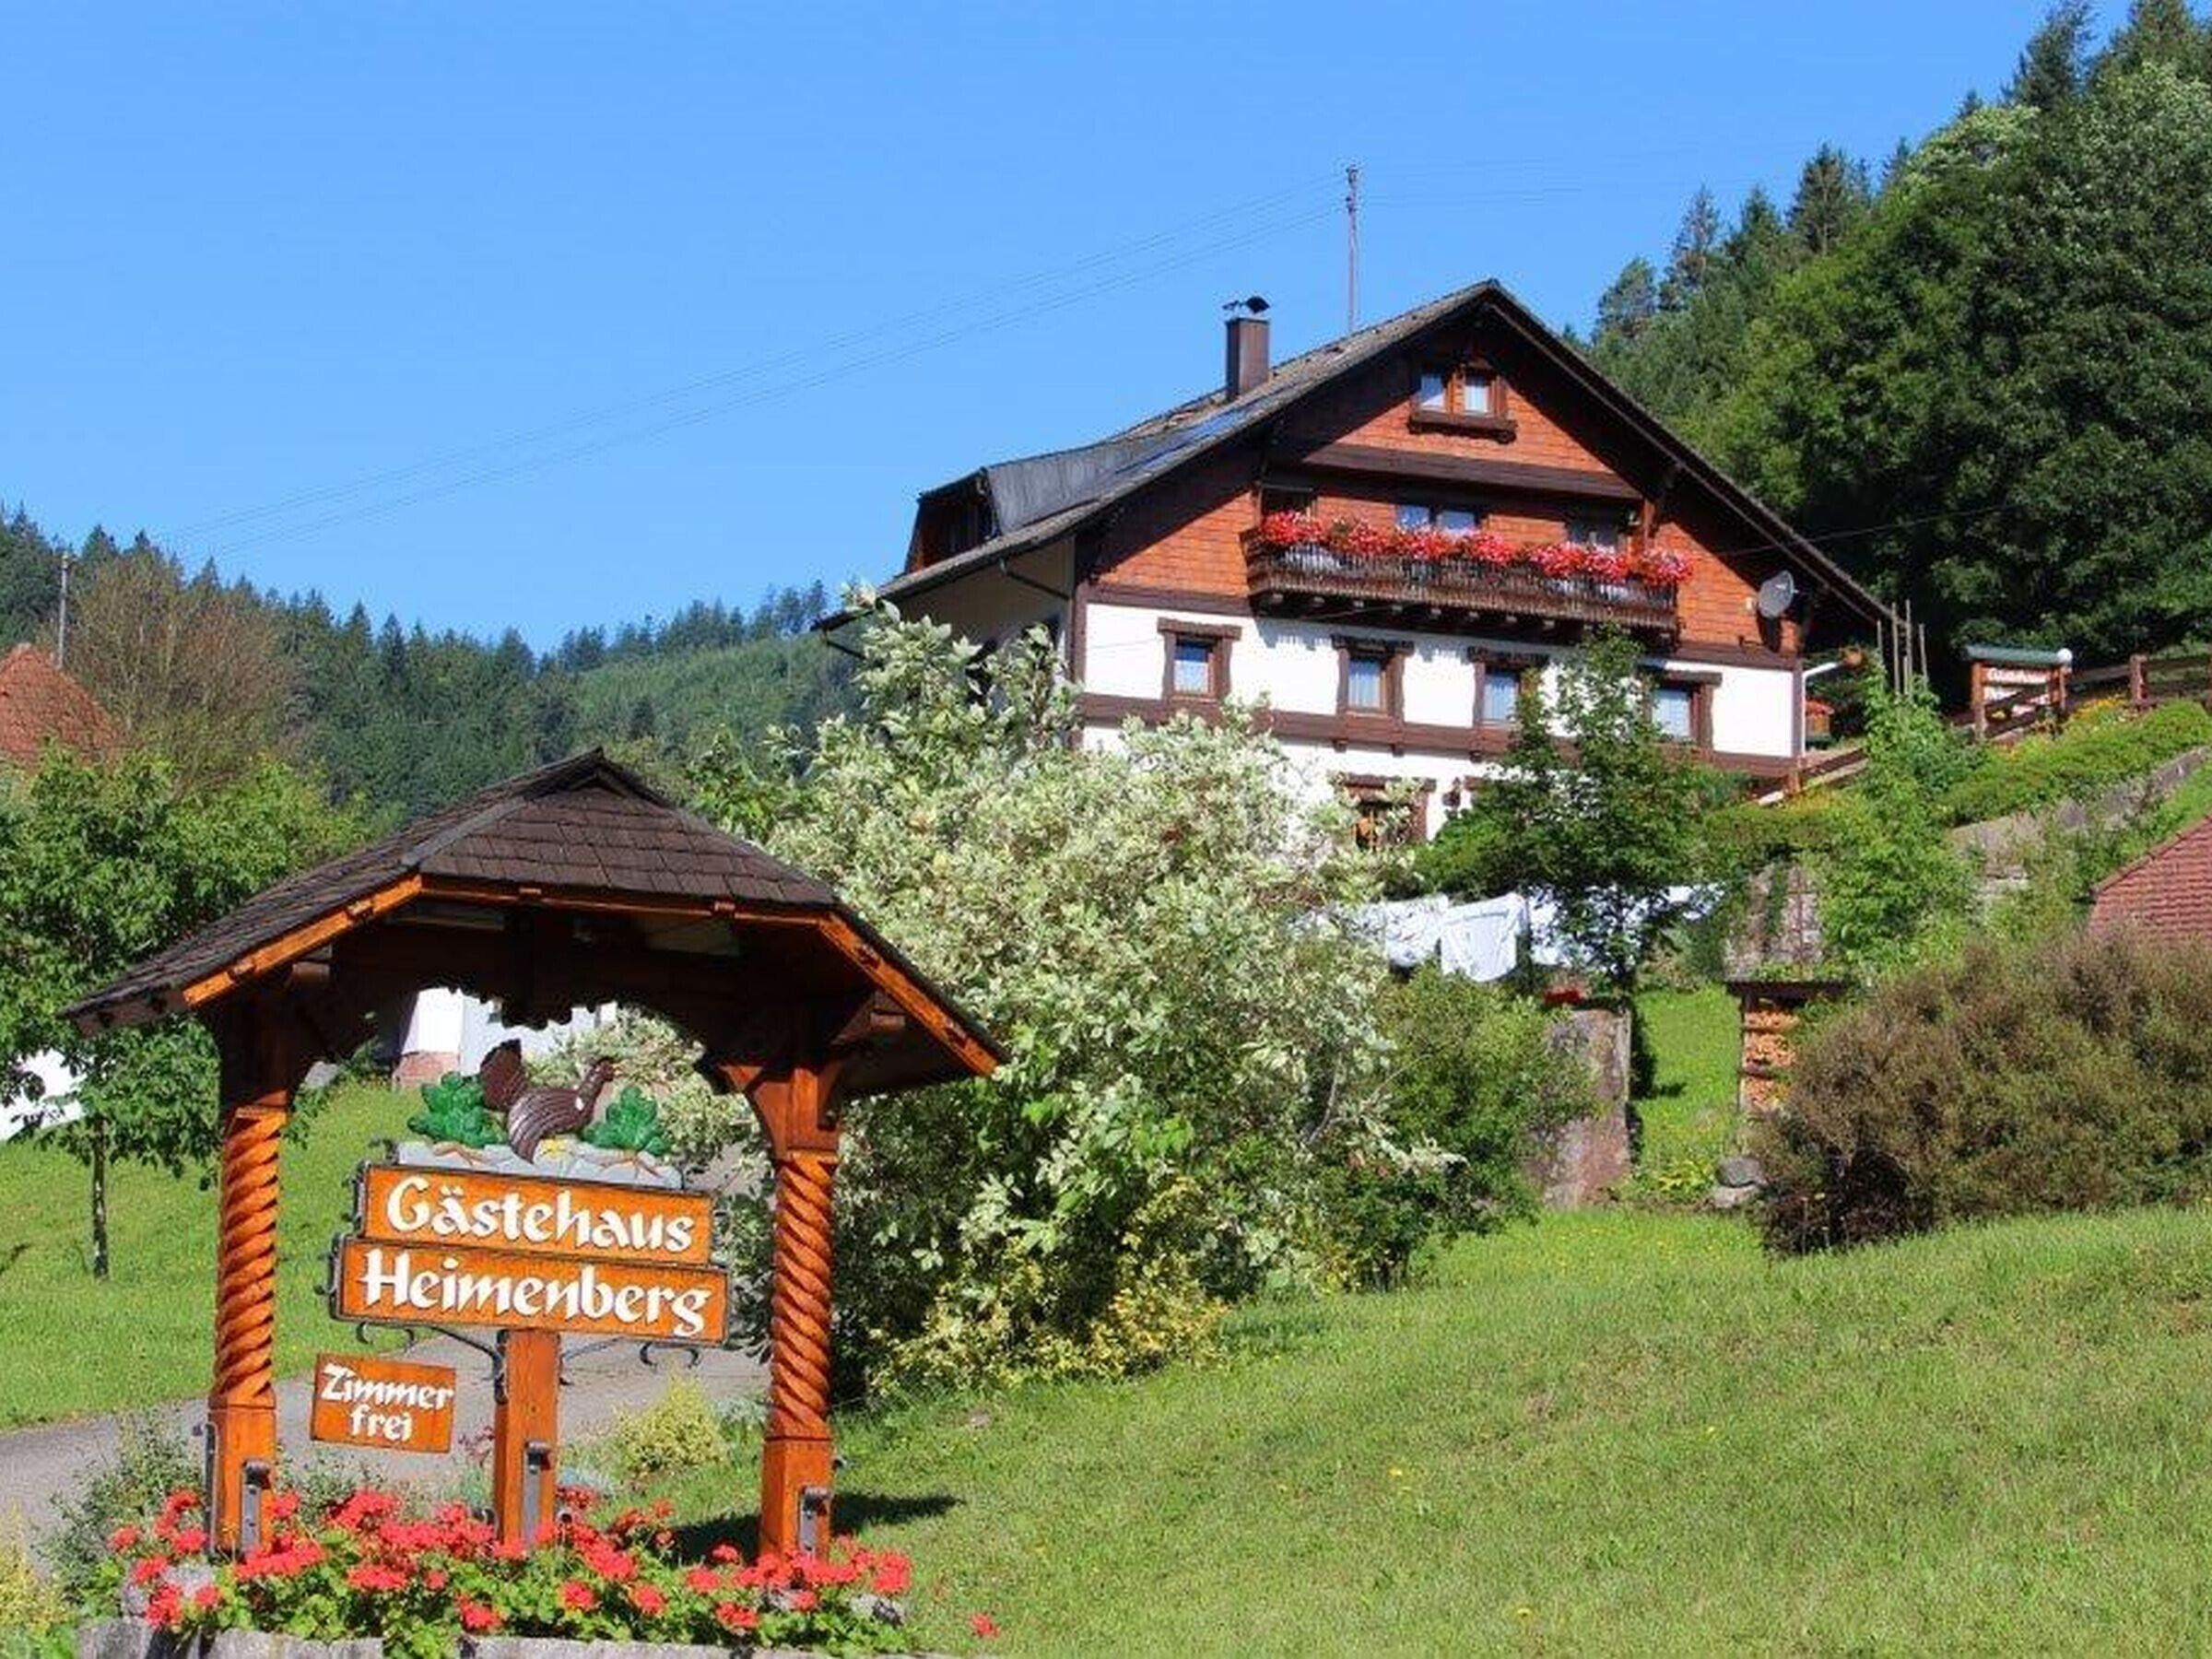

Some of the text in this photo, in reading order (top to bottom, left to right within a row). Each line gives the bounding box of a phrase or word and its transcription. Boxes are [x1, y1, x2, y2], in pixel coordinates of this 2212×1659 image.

[387, 1177, 695, 1253] Gästehaus
[359, 1249, 711, 1337] Heimenberg
[321, 1363, 454, 1410] Zimmer
[350, 1404, 413, 1441] frei
